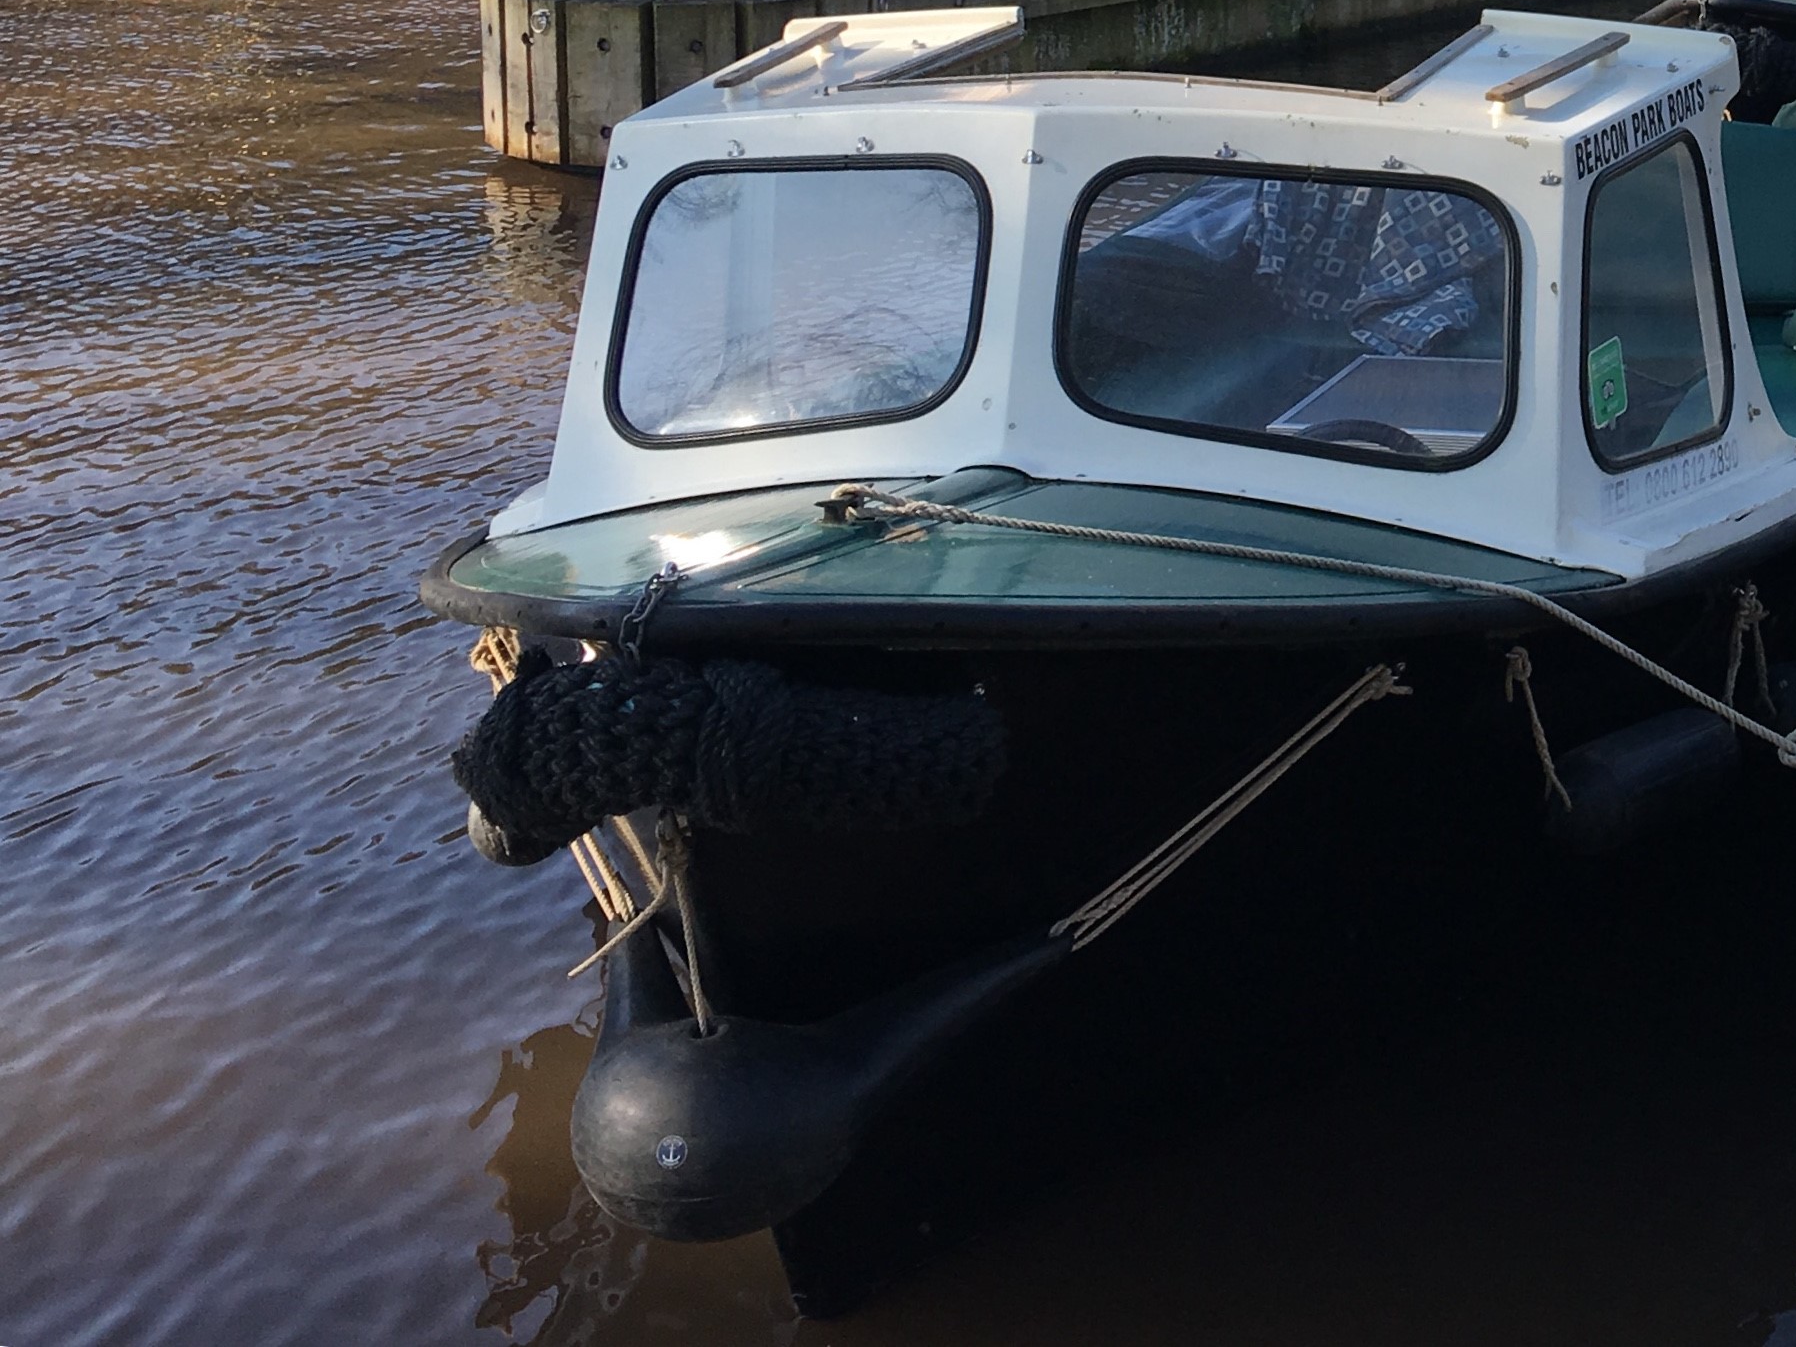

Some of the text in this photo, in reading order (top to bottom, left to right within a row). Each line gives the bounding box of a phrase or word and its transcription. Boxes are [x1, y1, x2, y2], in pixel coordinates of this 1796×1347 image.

[1575, 78, 1704, 180] BEACON PARK BOATS
[1682, 452, 1706, 490] 612
[1709, 438, 1739, 479] 2890
